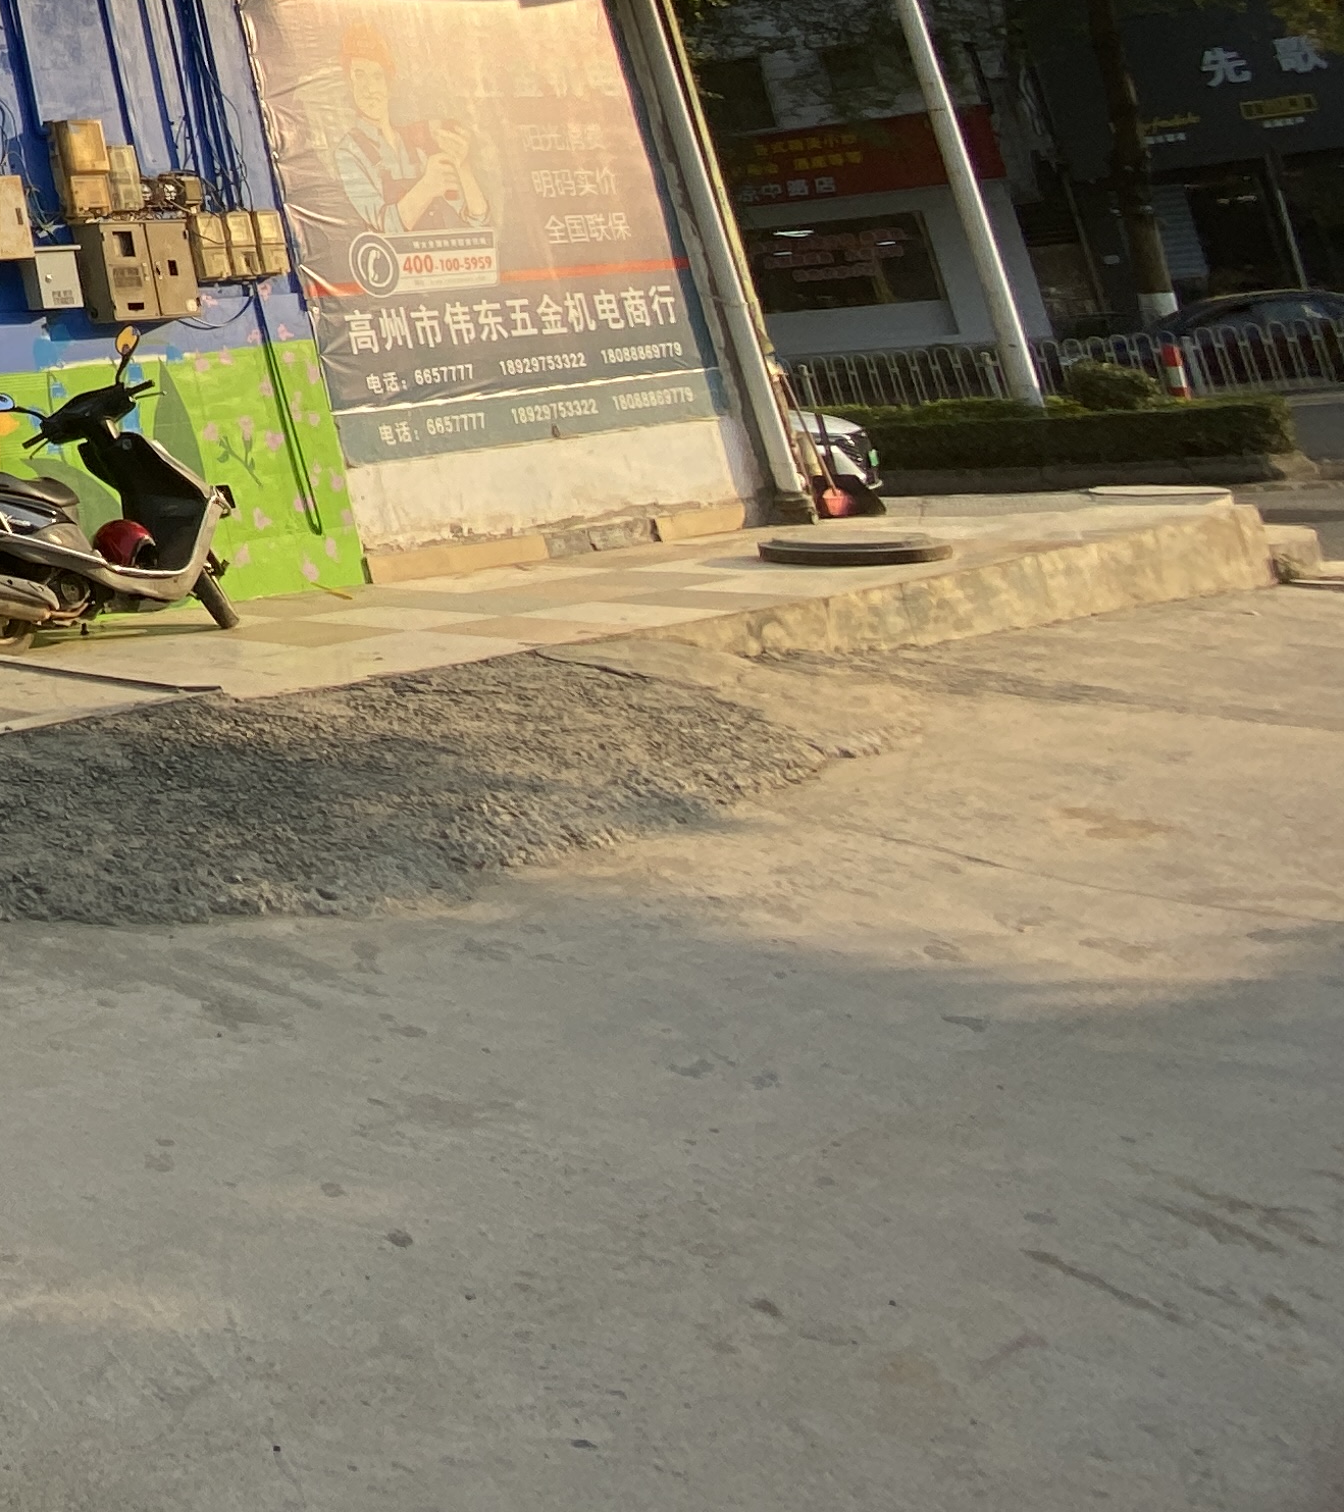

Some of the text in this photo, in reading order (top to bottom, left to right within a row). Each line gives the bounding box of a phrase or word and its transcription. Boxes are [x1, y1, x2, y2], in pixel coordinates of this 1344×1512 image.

[544, 212, 633, 244] 全国联保
[402, 254, 493, 275] 400-100-5959
[344, 285, 678, 355] 高州市伟东五金机电商行
[414, 363, 474, 386] 6657777
[499, 352, 587, 376] 18929753322
[600, 341, 683, 364] 18088869779
[426, 412, 486, 436] 6657777
[511, 399, 599, 424] 18929753322
